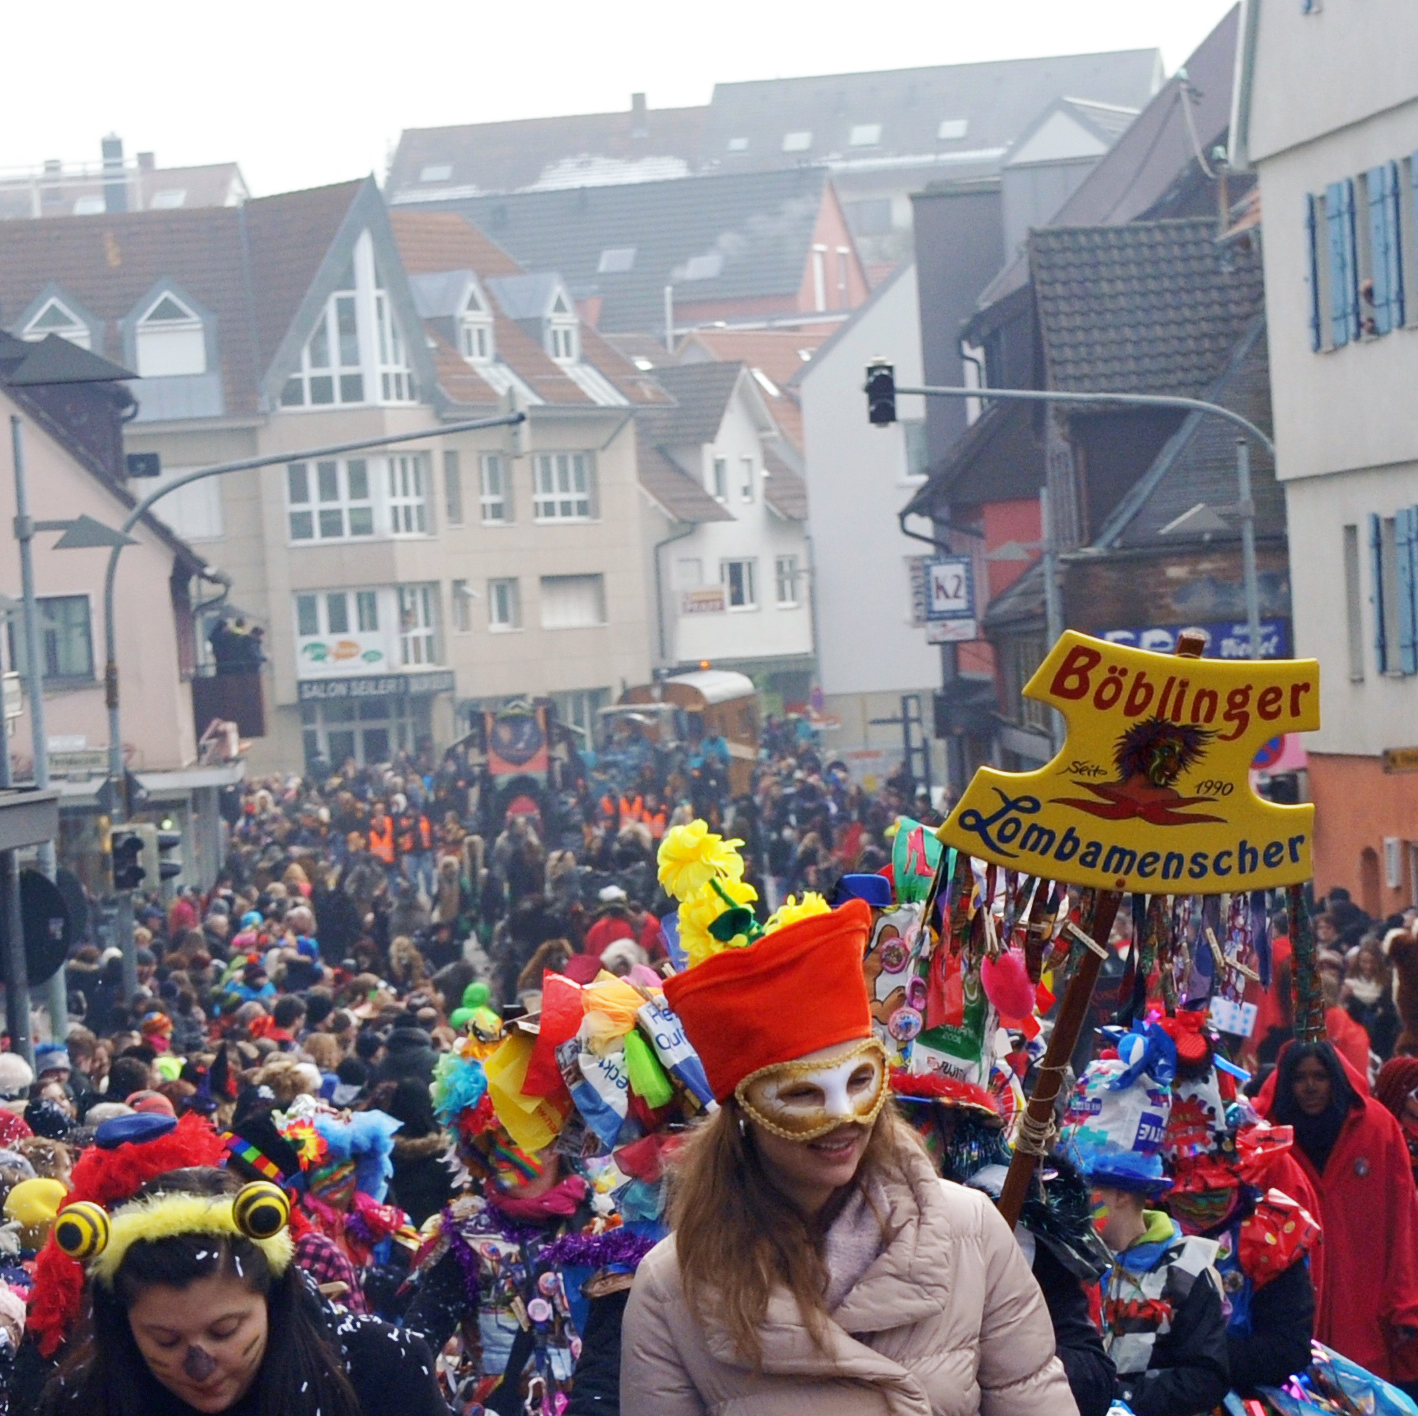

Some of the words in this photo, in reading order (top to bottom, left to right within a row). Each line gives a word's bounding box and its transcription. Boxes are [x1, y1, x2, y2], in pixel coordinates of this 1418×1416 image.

[301, 682, 347, 699] SALON
[1049, 644, 1311, 742] Böblinger
[1194, 780, 1236, 798] 1990
[958, 786, 1306, 881] Lombamenscher
